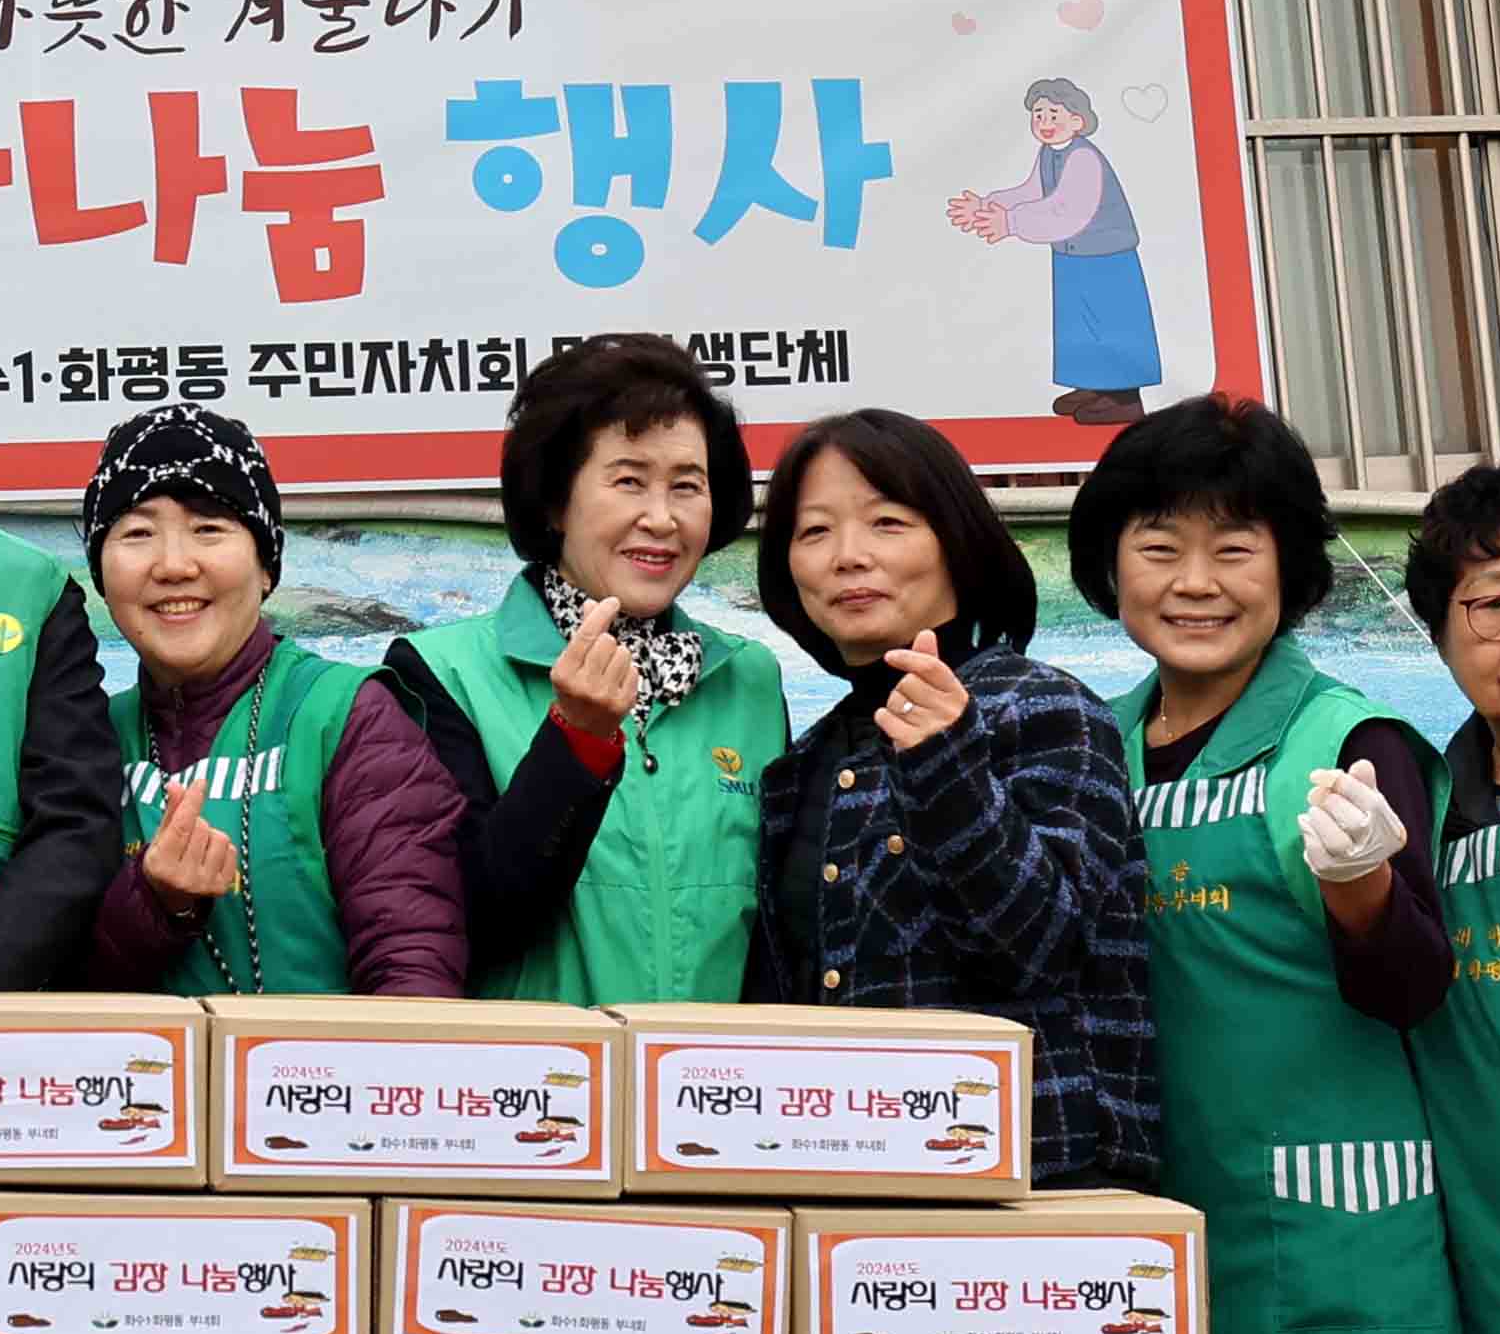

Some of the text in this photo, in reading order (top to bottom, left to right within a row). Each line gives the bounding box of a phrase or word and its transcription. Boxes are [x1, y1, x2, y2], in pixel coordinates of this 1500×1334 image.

[445, 78, 894, 289] 행사
[248, 337, 528, 400] 주민자치회
[670, 329, 850, 387] 생단체
[681, 1065, 748, 1081] 2024년도
[675, 1084, 763, 1115] 사랑의
[777, 1088, 835, 1117] 김장
[855, 1260, 922, 1276] 2024년도
[848, 1280, 938, 1310] 사랑의
[951, 1281, 1010, 1311] 김장
